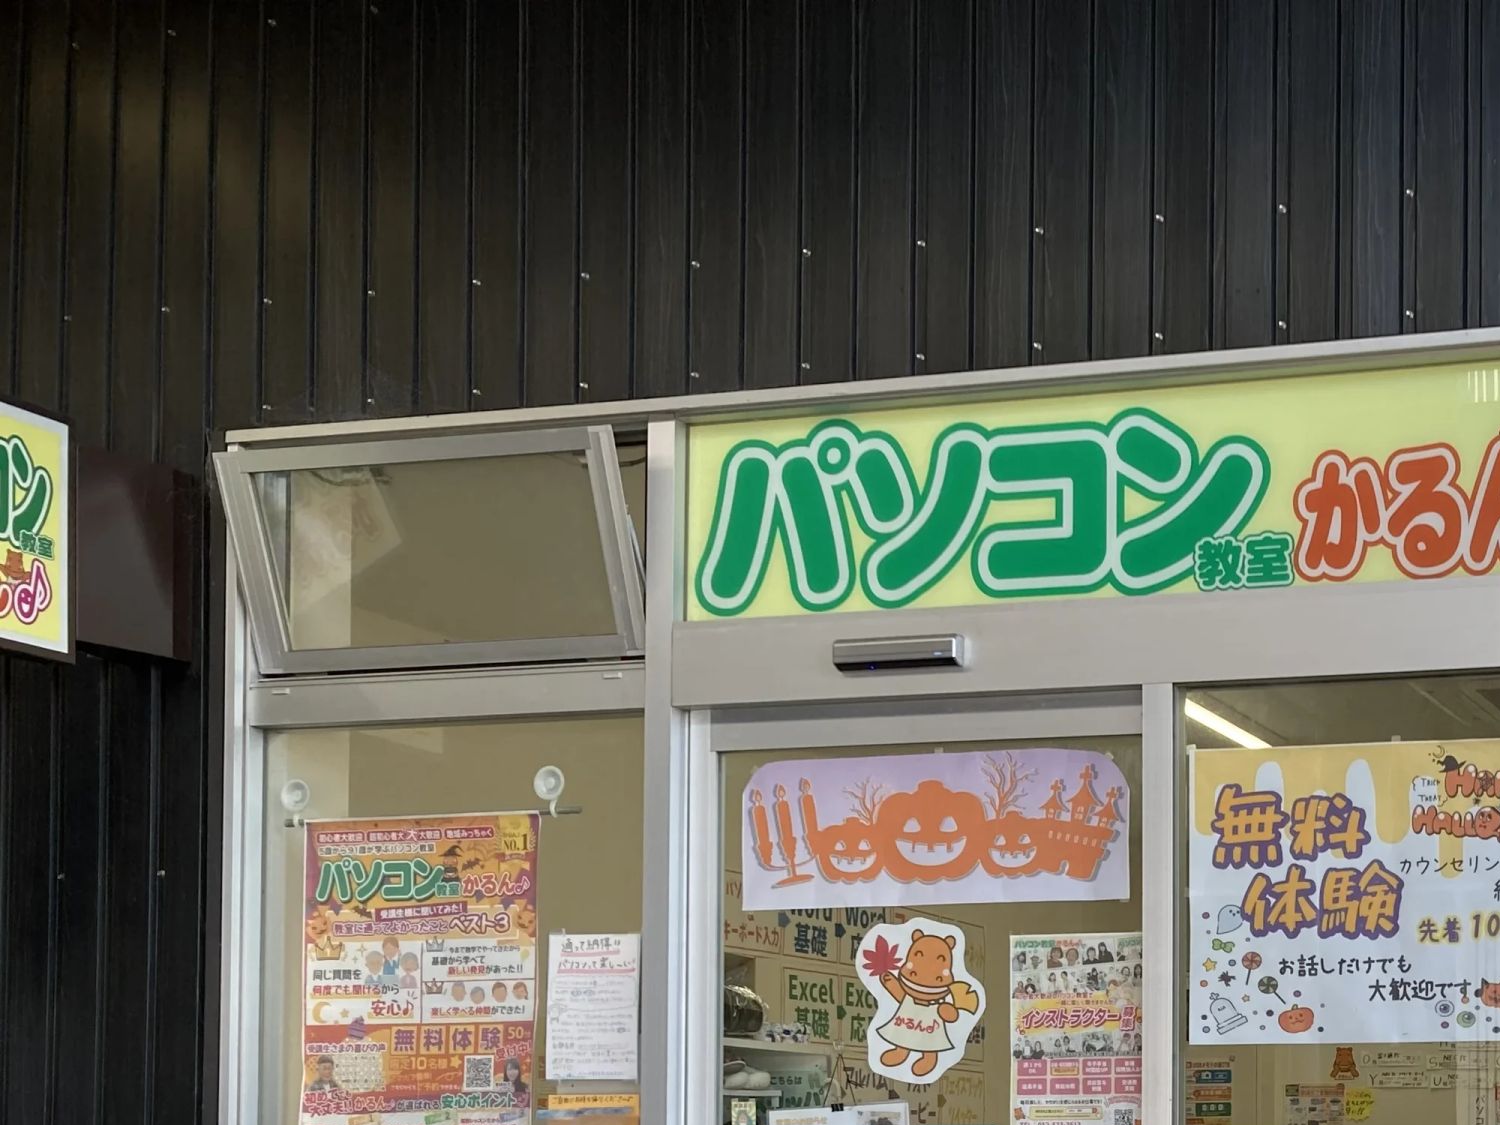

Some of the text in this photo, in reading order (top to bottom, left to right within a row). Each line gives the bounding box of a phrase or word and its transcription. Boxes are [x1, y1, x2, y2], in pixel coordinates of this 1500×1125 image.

[695, 407, 1270, 617] パソコン
[1194, 531, 1294, 590] 教室
[20, 530, 54, 560] 教室
[1212, 783, 1370, 869] 無料
[316, 857, 444, 902] パソコン
[1242, 860, 1404, 940] 体験
[450, 912, 512, 934] ベスト3
[794, 922, 828, 957] 基礎
[1278, 954, 1412, 977] お話しだけでも
[789, 975, 835, 1004] Excel
[1368, 979, 1472, 1002] 大歓迎です
[795, 1006, 830, 1039] 基礎
[1022, 1007, 1120, 1028] インストラクター
[393, 1025, 502, 1051] 無料体験
